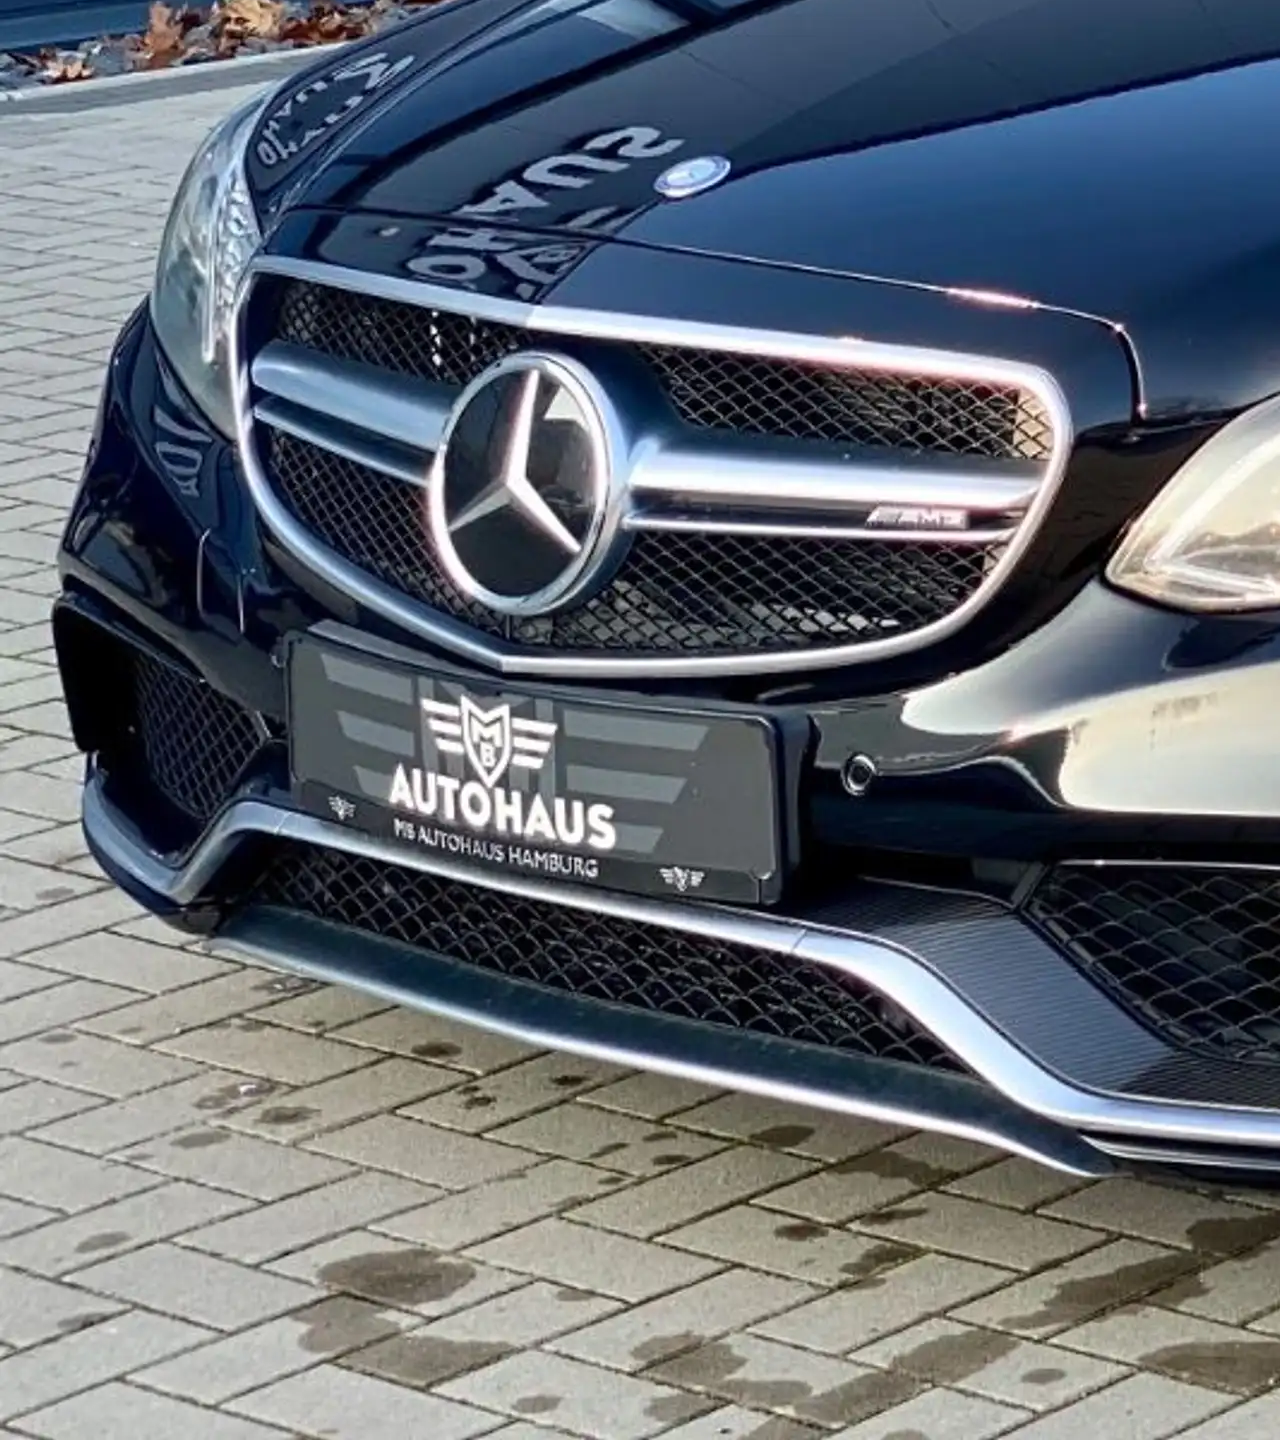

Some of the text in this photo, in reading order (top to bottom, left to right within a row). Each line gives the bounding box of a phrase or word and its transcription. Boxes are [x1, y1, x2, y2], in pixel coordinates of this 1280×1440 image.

[388, 763, 617, 849] AUTOHAUS
[394, 818, 599, 878] MB AUTOHAUS HAMBURG
